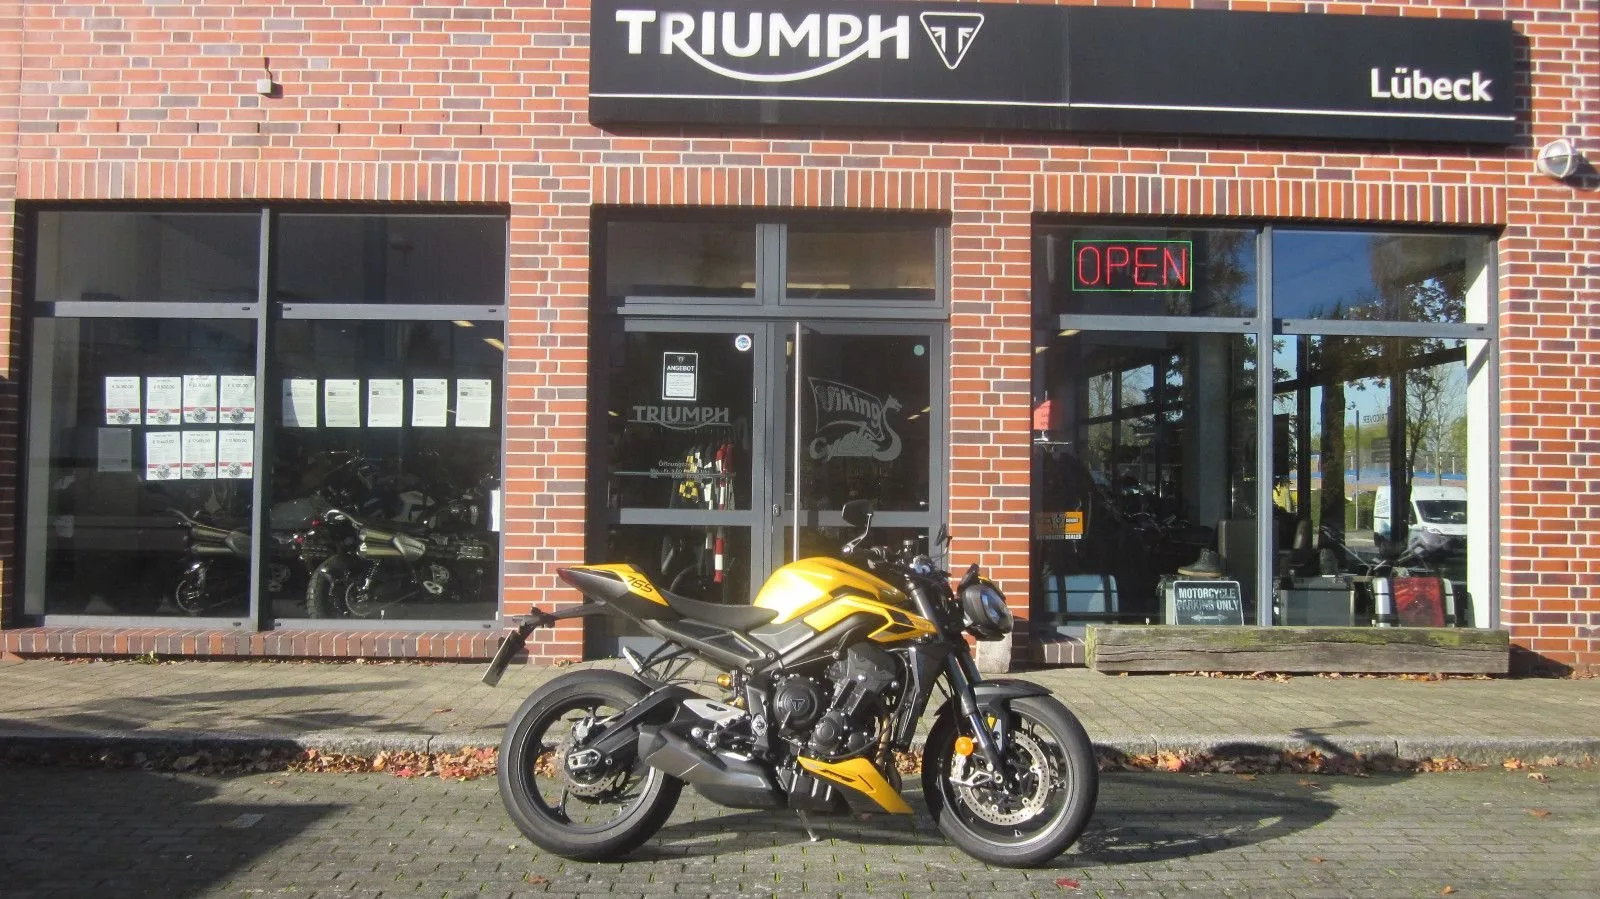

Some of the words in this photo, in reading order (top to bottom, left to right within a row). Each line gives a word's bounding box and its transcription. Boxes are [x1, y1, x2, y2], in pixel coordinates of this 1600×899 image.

[615, 10, 910, 82] TRIUMPH
[1371, 66, 1492, 102] Lübeck
[1077, 245, 1188, 287] OPEN
[632, 406, 729, 430] TRIUMPH
[815, 385, 880, 428] Viking
[627, 575, 652, 592] 765
[1178, 587, 1236, 599] MOTORCYCLE
[1176, 599, 1215, 611] PARKING
[1216, 600, 1239, 611] ONLY
